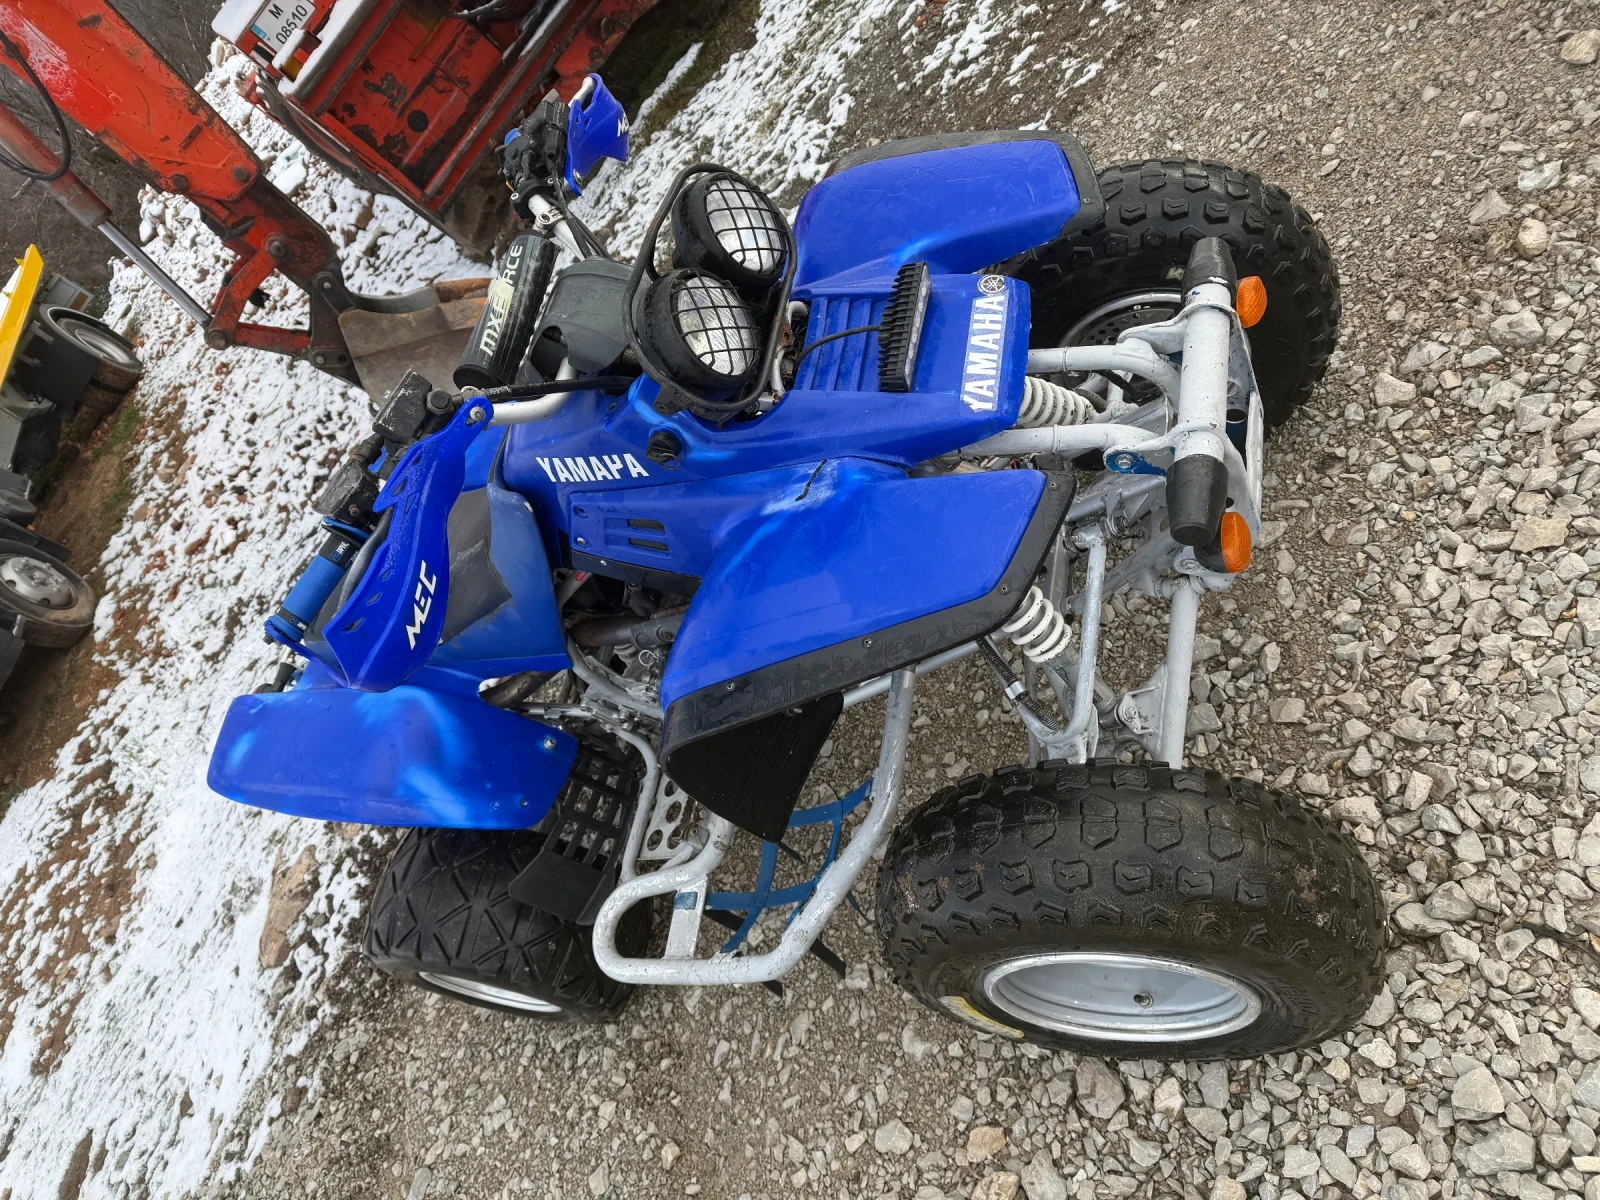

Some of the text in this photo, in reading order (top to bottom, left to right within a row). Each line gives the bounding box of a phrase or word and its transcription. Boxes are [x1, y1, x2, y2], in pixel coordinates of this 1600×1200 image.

[268, 3, 284, 19] M
[276, 4, 308, 45] 08510
[492, 244, 523, 314] FRCE
[962, 294, 1005, 413] YAMAHA
[405, 559, 437, 651] MEC
